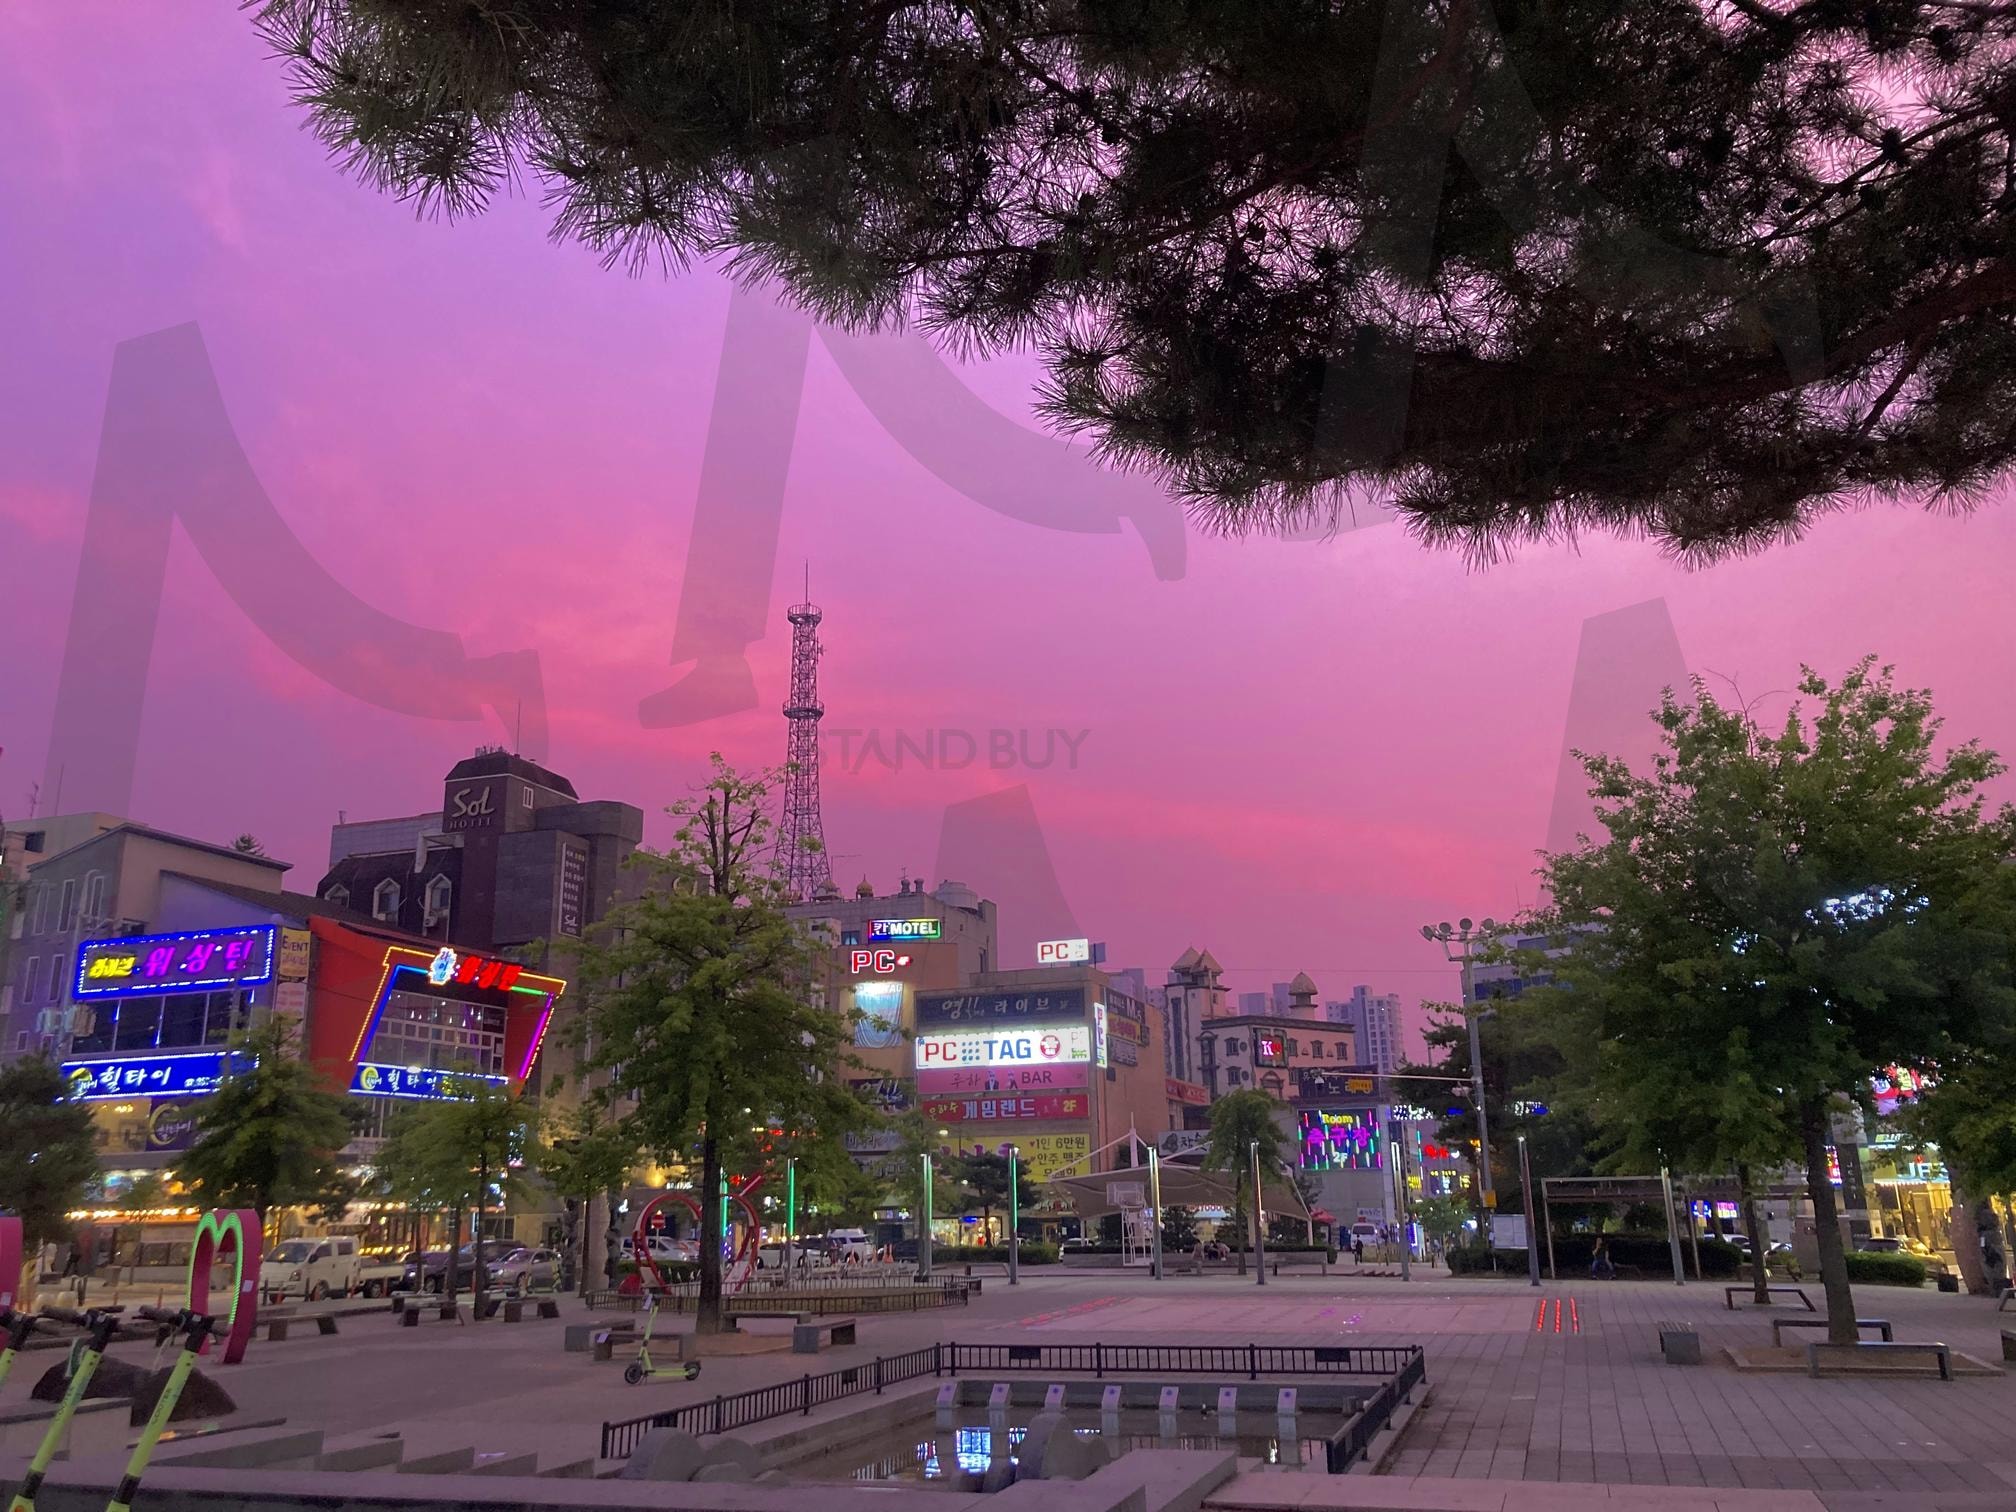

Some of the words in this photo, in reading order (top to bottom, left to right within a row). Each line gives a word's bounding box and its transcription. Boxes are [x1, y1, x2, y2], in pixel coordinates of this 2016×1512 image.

[890, 922, 937, 935] MOTEL
[1040, 943, 1069, 961] PC
[851, 949, 895, 974] PC
[924, 1042, 957, 1062] PC
[983, 1038, 1032, 1060] TAG
[1021, 1071, 1053, 1085] BAR
[962, 1099, 1035, 1120] 게임랜드
[1063, 1099, 1077, 1113] 2F
[1322, 1113, 1353, 1124] Room
[1056, 1136, 1086, 1150] 6만원
